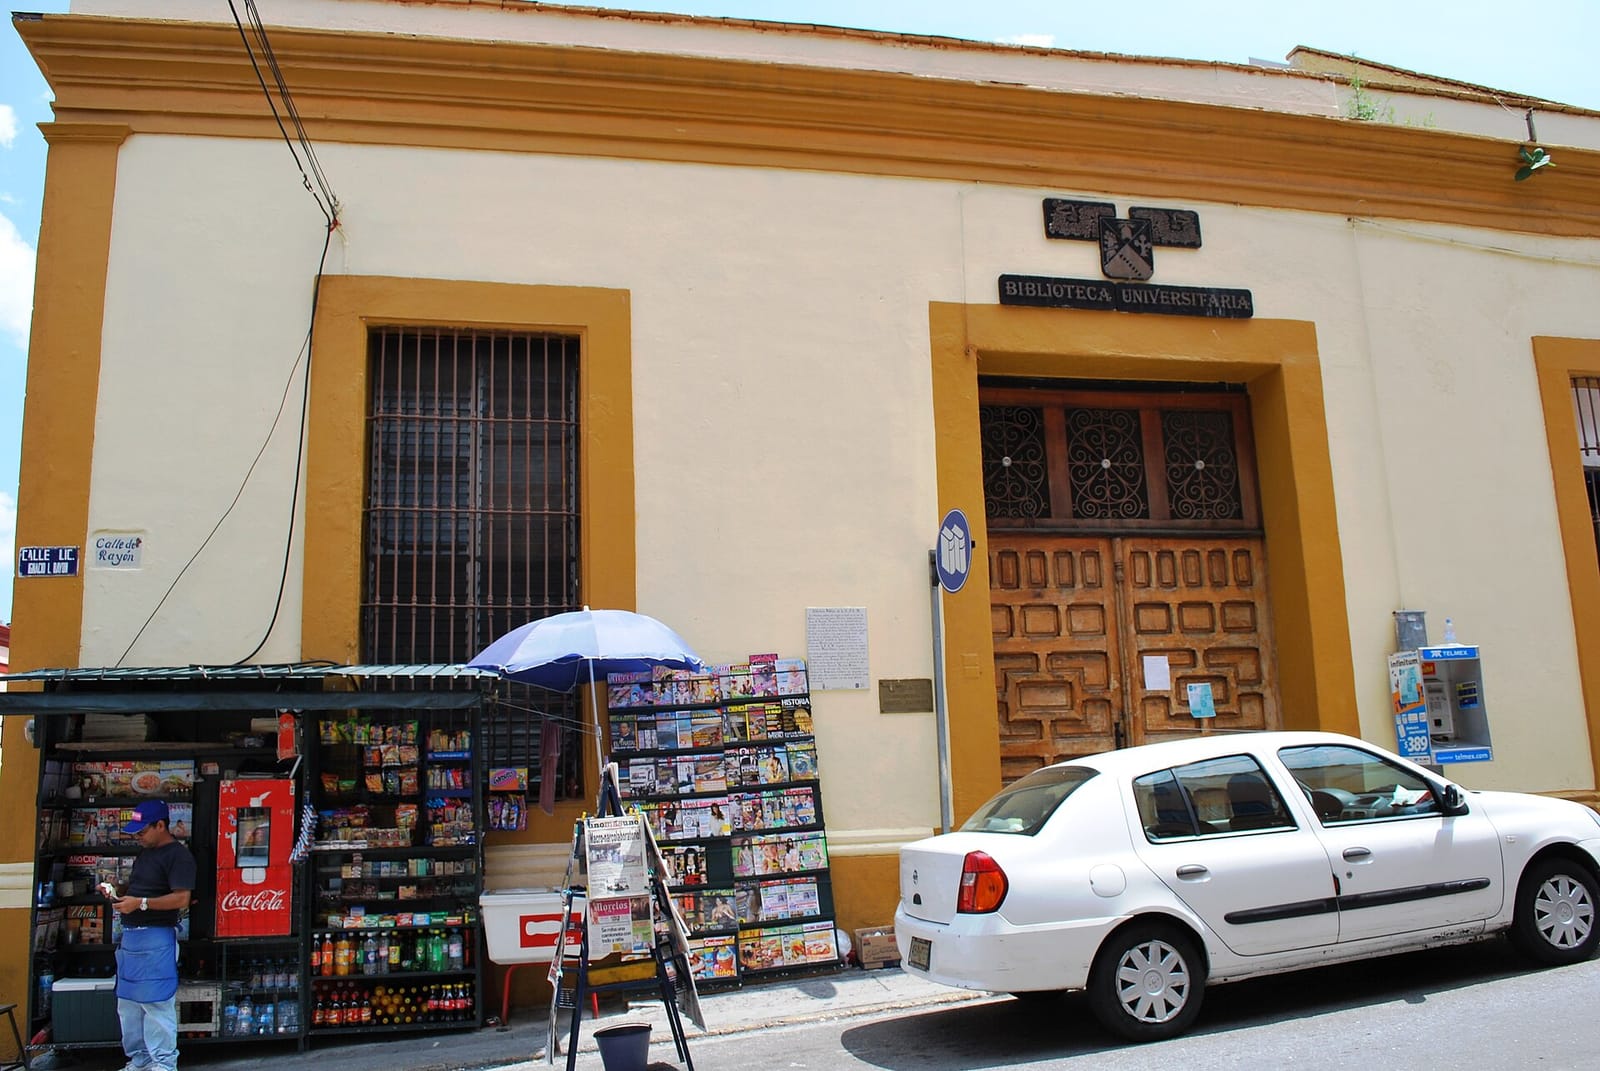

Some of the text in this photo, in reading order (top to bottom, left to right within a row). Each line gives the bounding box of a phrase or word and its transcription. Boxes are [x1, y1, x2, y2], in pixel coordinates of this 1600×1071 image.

[1006, 280, 1250, 310] BIBLIOTECA UNIVERSITARIA
[96, 537, 124, 549] Calle
[21, 549, 75, 561] CALLE LIC.
[98, 550, 134, 566] Rayón
[781, 698, 810, 706] HISTORIA
[1404, 736, 1428, 752] $389
[1454, 753, 1488, 761] telmex.com
[221, 889, 286, 912] Coca-Cola
